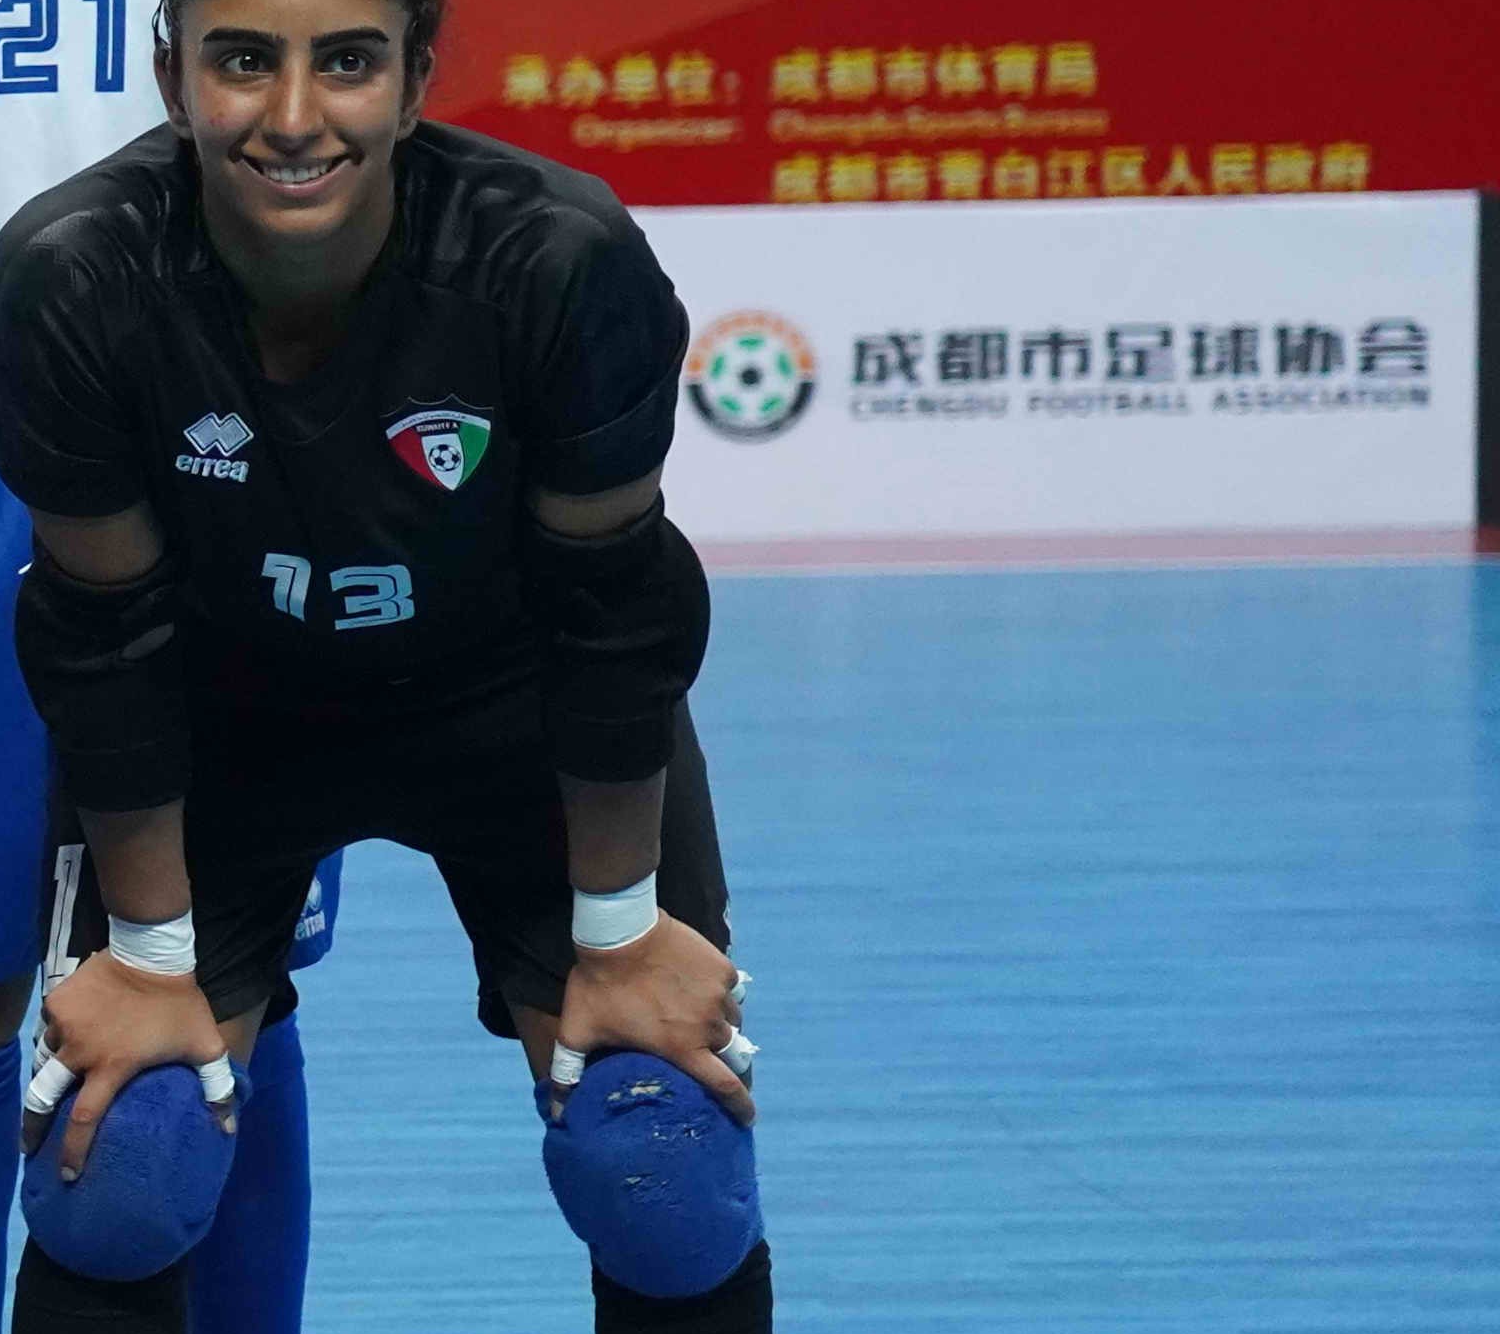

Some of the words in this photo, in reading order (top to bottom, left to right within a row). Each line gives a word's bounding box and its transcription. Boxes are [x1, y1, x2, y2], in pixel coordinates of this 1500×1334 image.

[850, 317, 1432, 388] 成都市足球协会
[850, 393, 1009, 421] CHENGDU
[1027, 390, 1190, 417] FOOTBALL
[1210, 386, 1432, 413] ASSOCIATION
[174, 453, 250, 484] errea
[260, 552, 416, 630] 13
